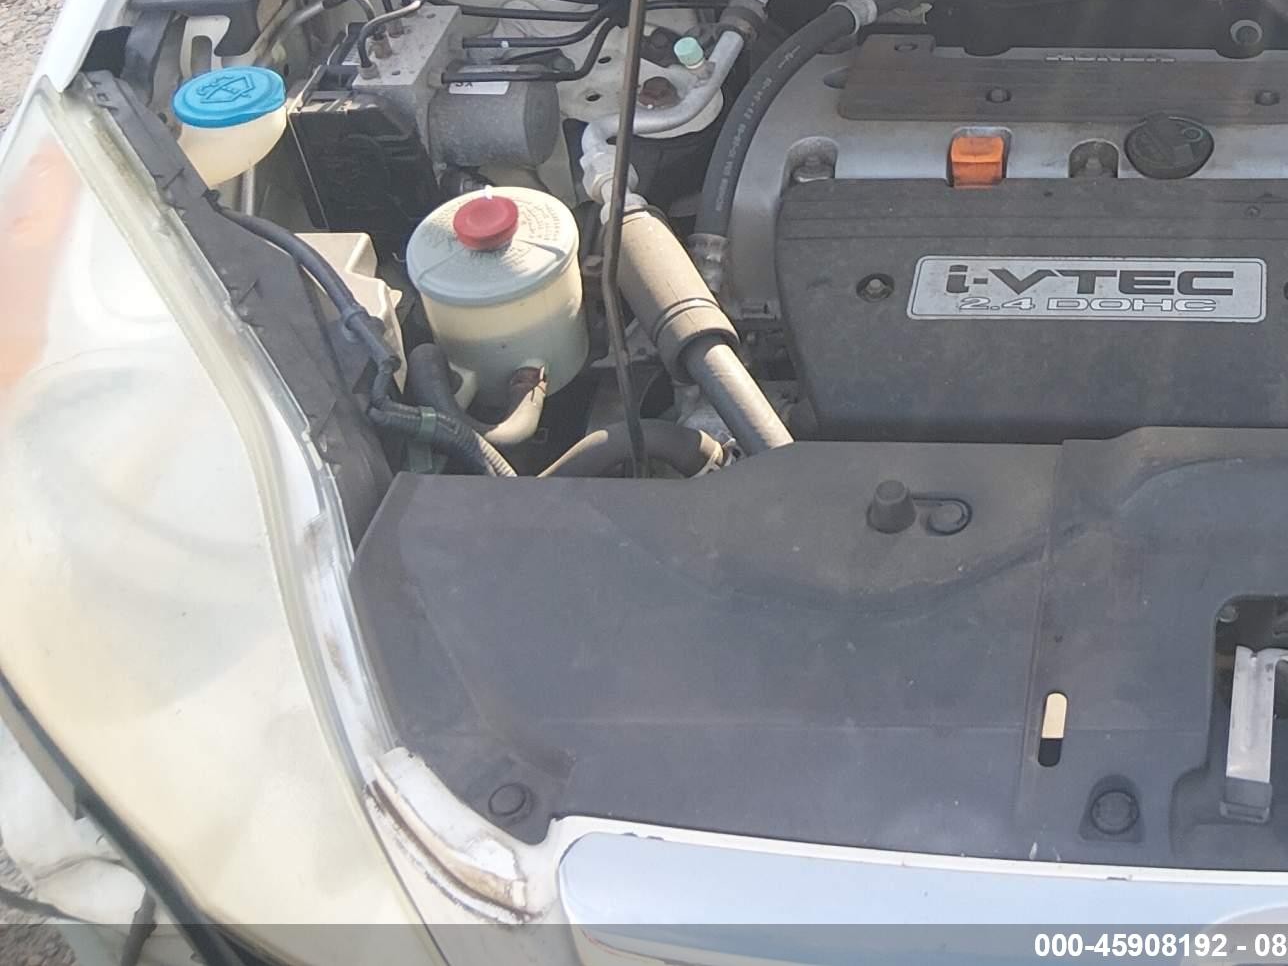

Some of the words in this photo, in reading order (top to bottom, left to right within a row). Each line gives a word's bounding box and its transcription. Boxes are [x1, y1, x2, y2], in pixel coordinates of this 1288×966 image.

[945, 263, 1234, 296] i-VTEC
[958, 296, 1035, 312] 2.4
[1046, 297, 1218, 313] DOHC
